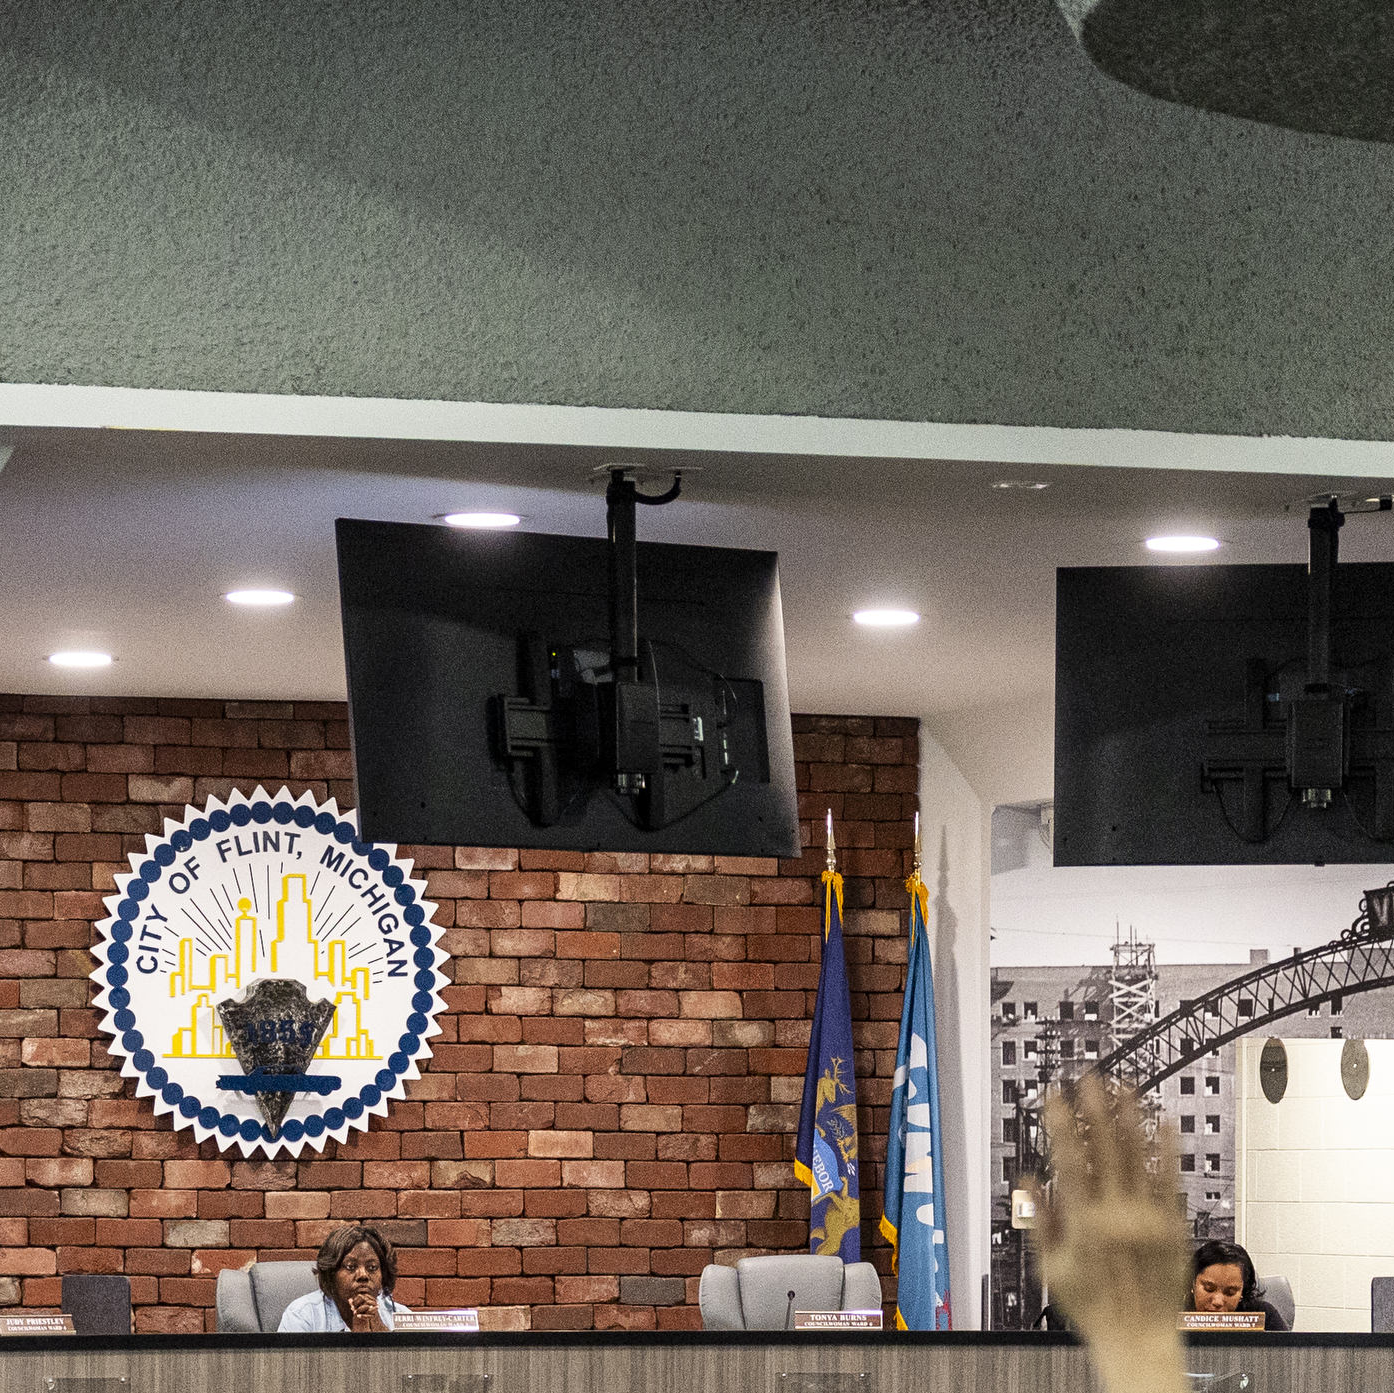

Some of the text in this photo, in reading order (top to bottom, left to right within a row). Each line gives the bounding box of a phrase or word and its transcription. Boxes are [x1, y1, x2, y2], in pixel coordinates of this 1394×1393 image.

[136, 830, 408, 979] CITY OF FLINT, MICHIGAN
